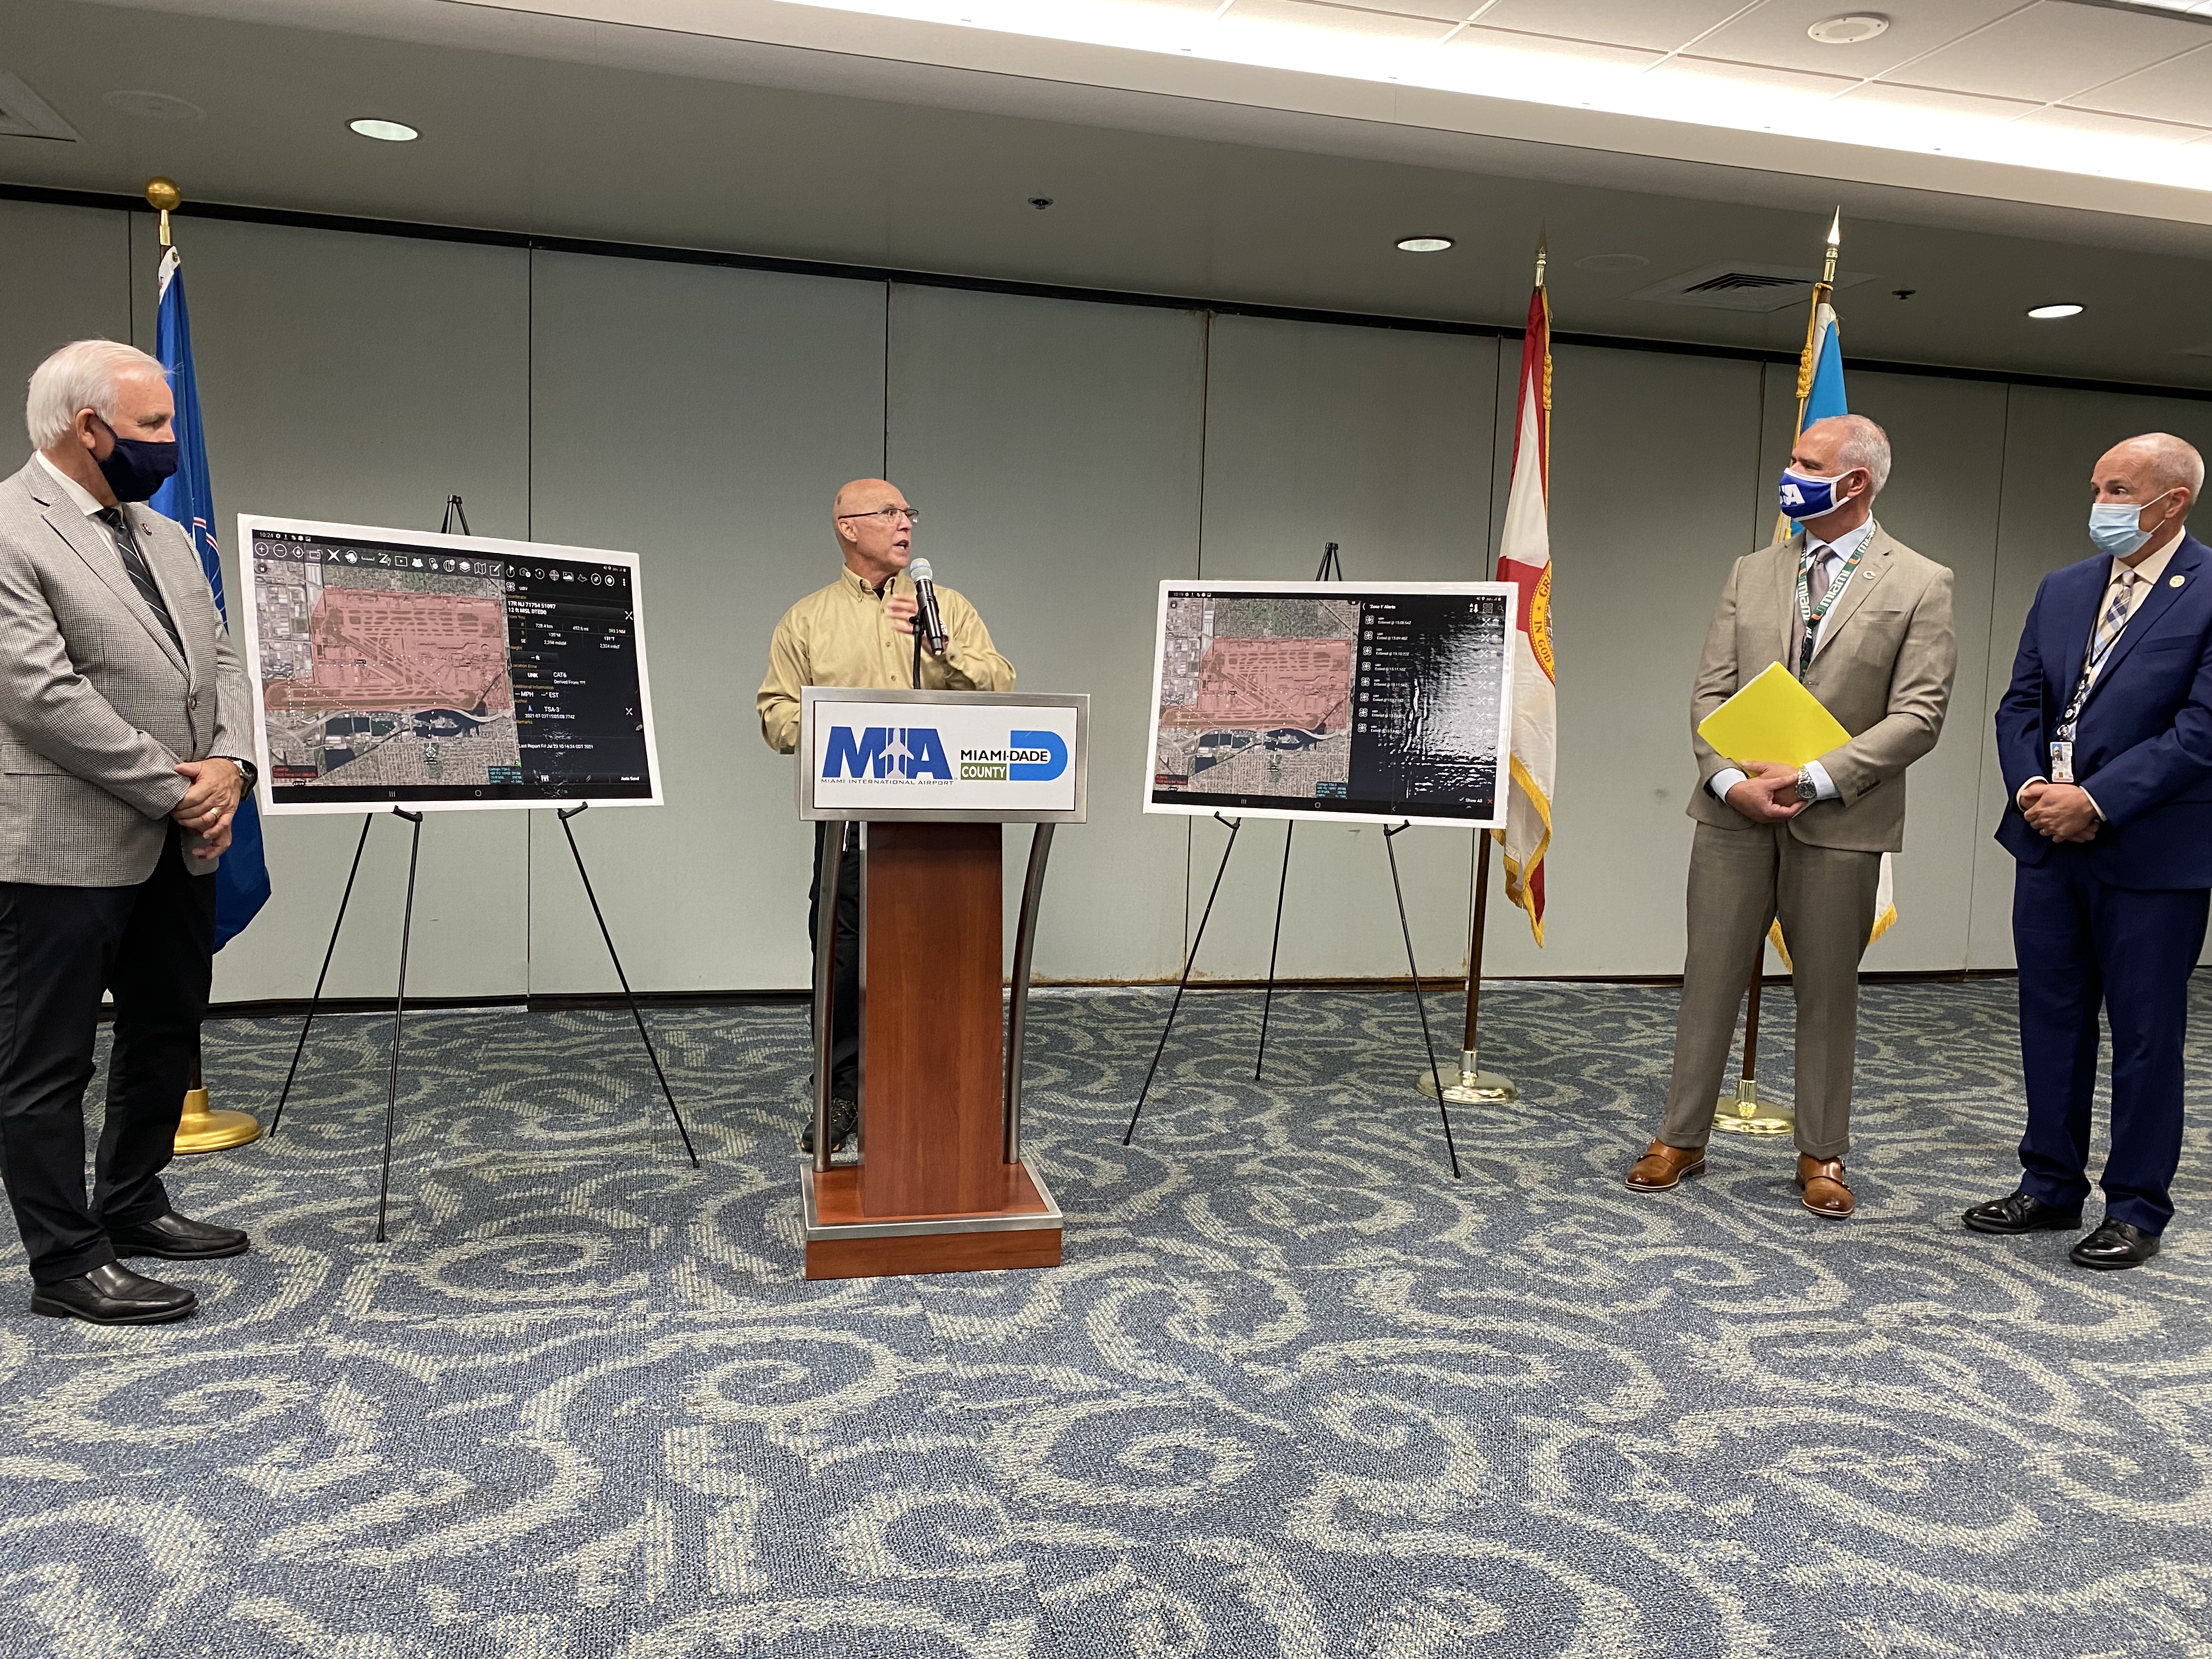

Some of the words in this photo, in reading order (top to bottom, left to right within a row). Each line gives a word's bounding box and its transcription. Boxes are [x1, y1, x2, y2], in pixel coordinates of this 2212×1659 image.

[1534, 621, 1543, 633] IN
[1538, 639, 1551, 663] GOD
[822, 726, 953, 780] MIA
[961, 766, 1006, 778] COUNTY
